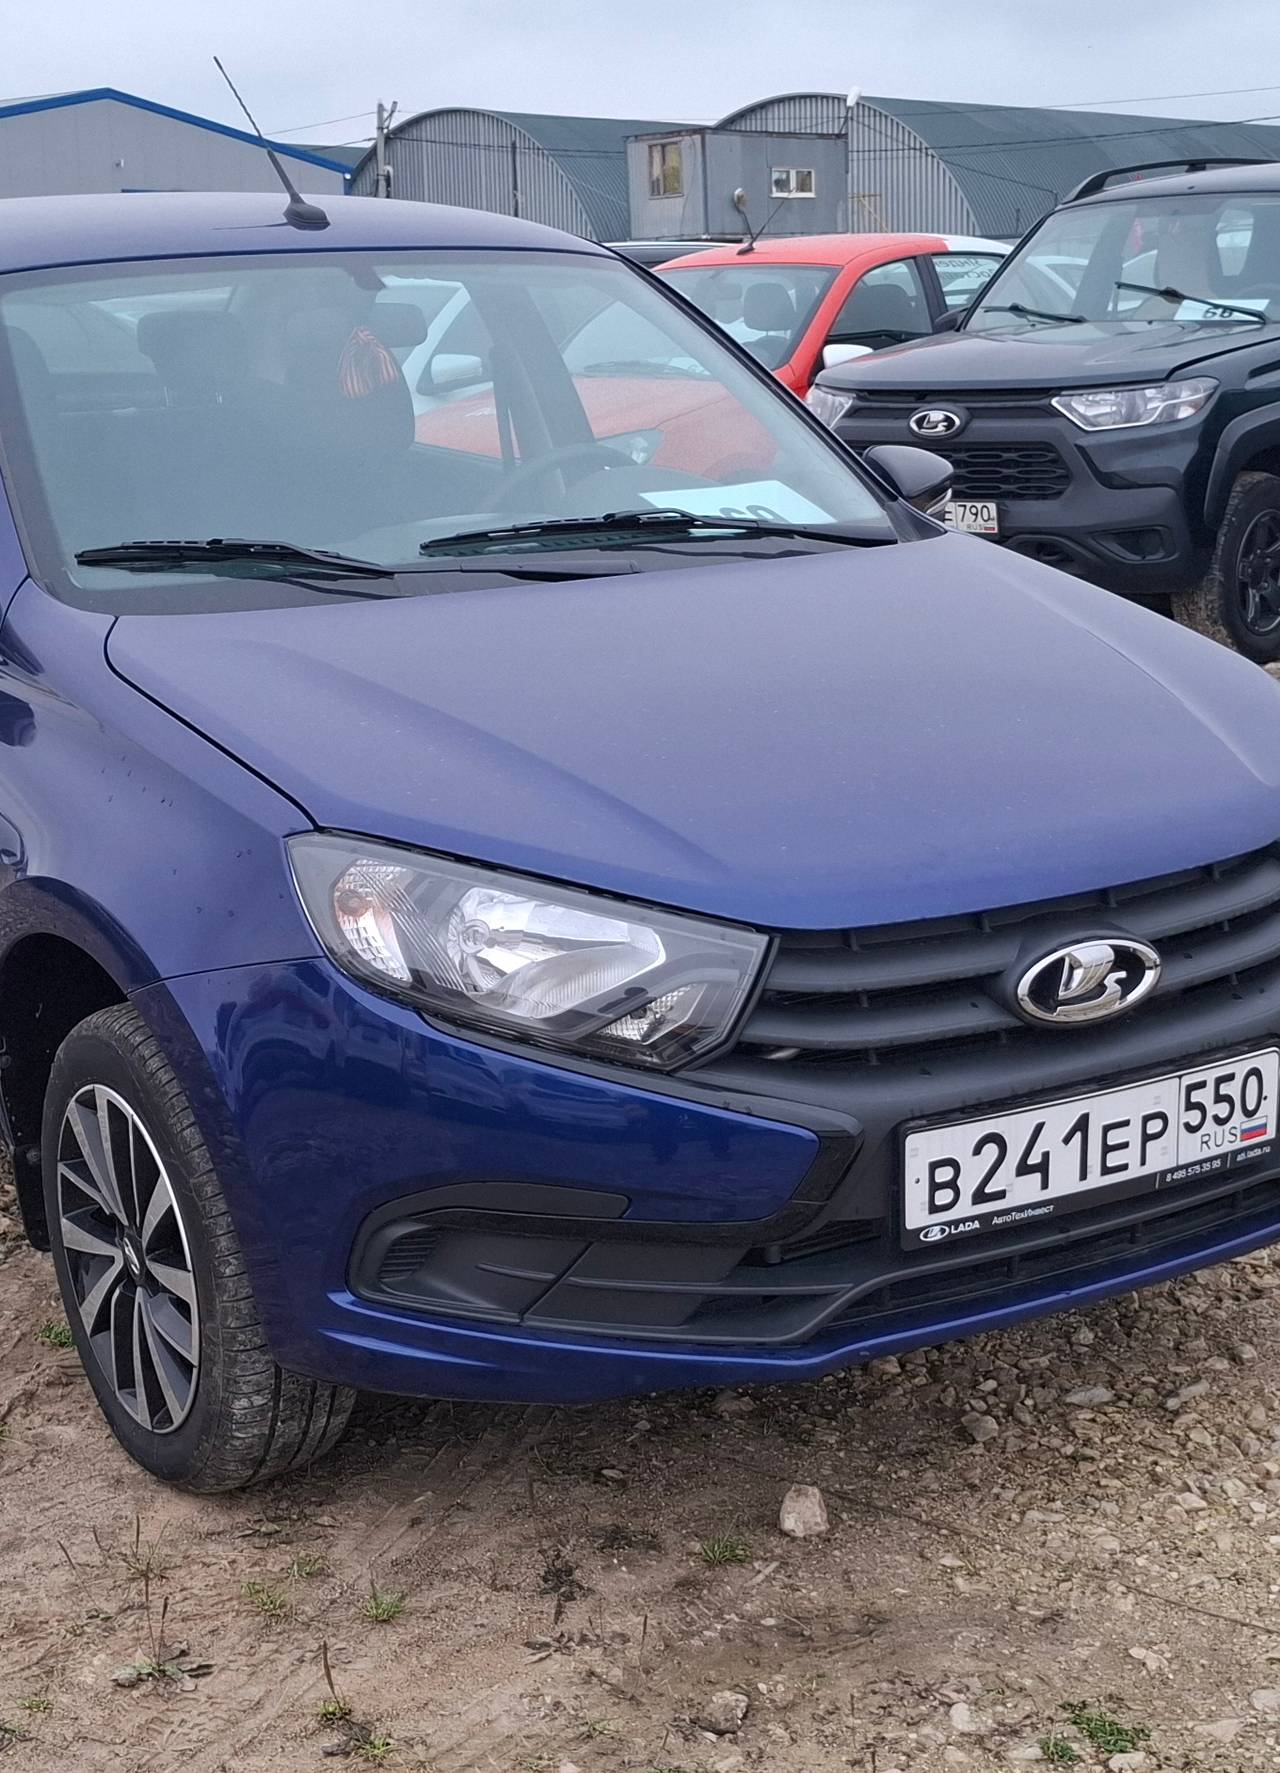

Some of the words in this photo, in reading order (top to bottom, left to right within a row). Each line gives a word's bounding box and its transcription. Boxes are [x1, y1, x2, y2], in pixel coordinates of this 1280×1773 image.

[957, 504, 991, 523] 790
[928, 1110, 1169, 1215] В241ЕР
[1182, 1066, 1264, 1134] 550
[1200, 1126, 1238, 1153] RUS
[950, 1220, 980, 1234] LADA
